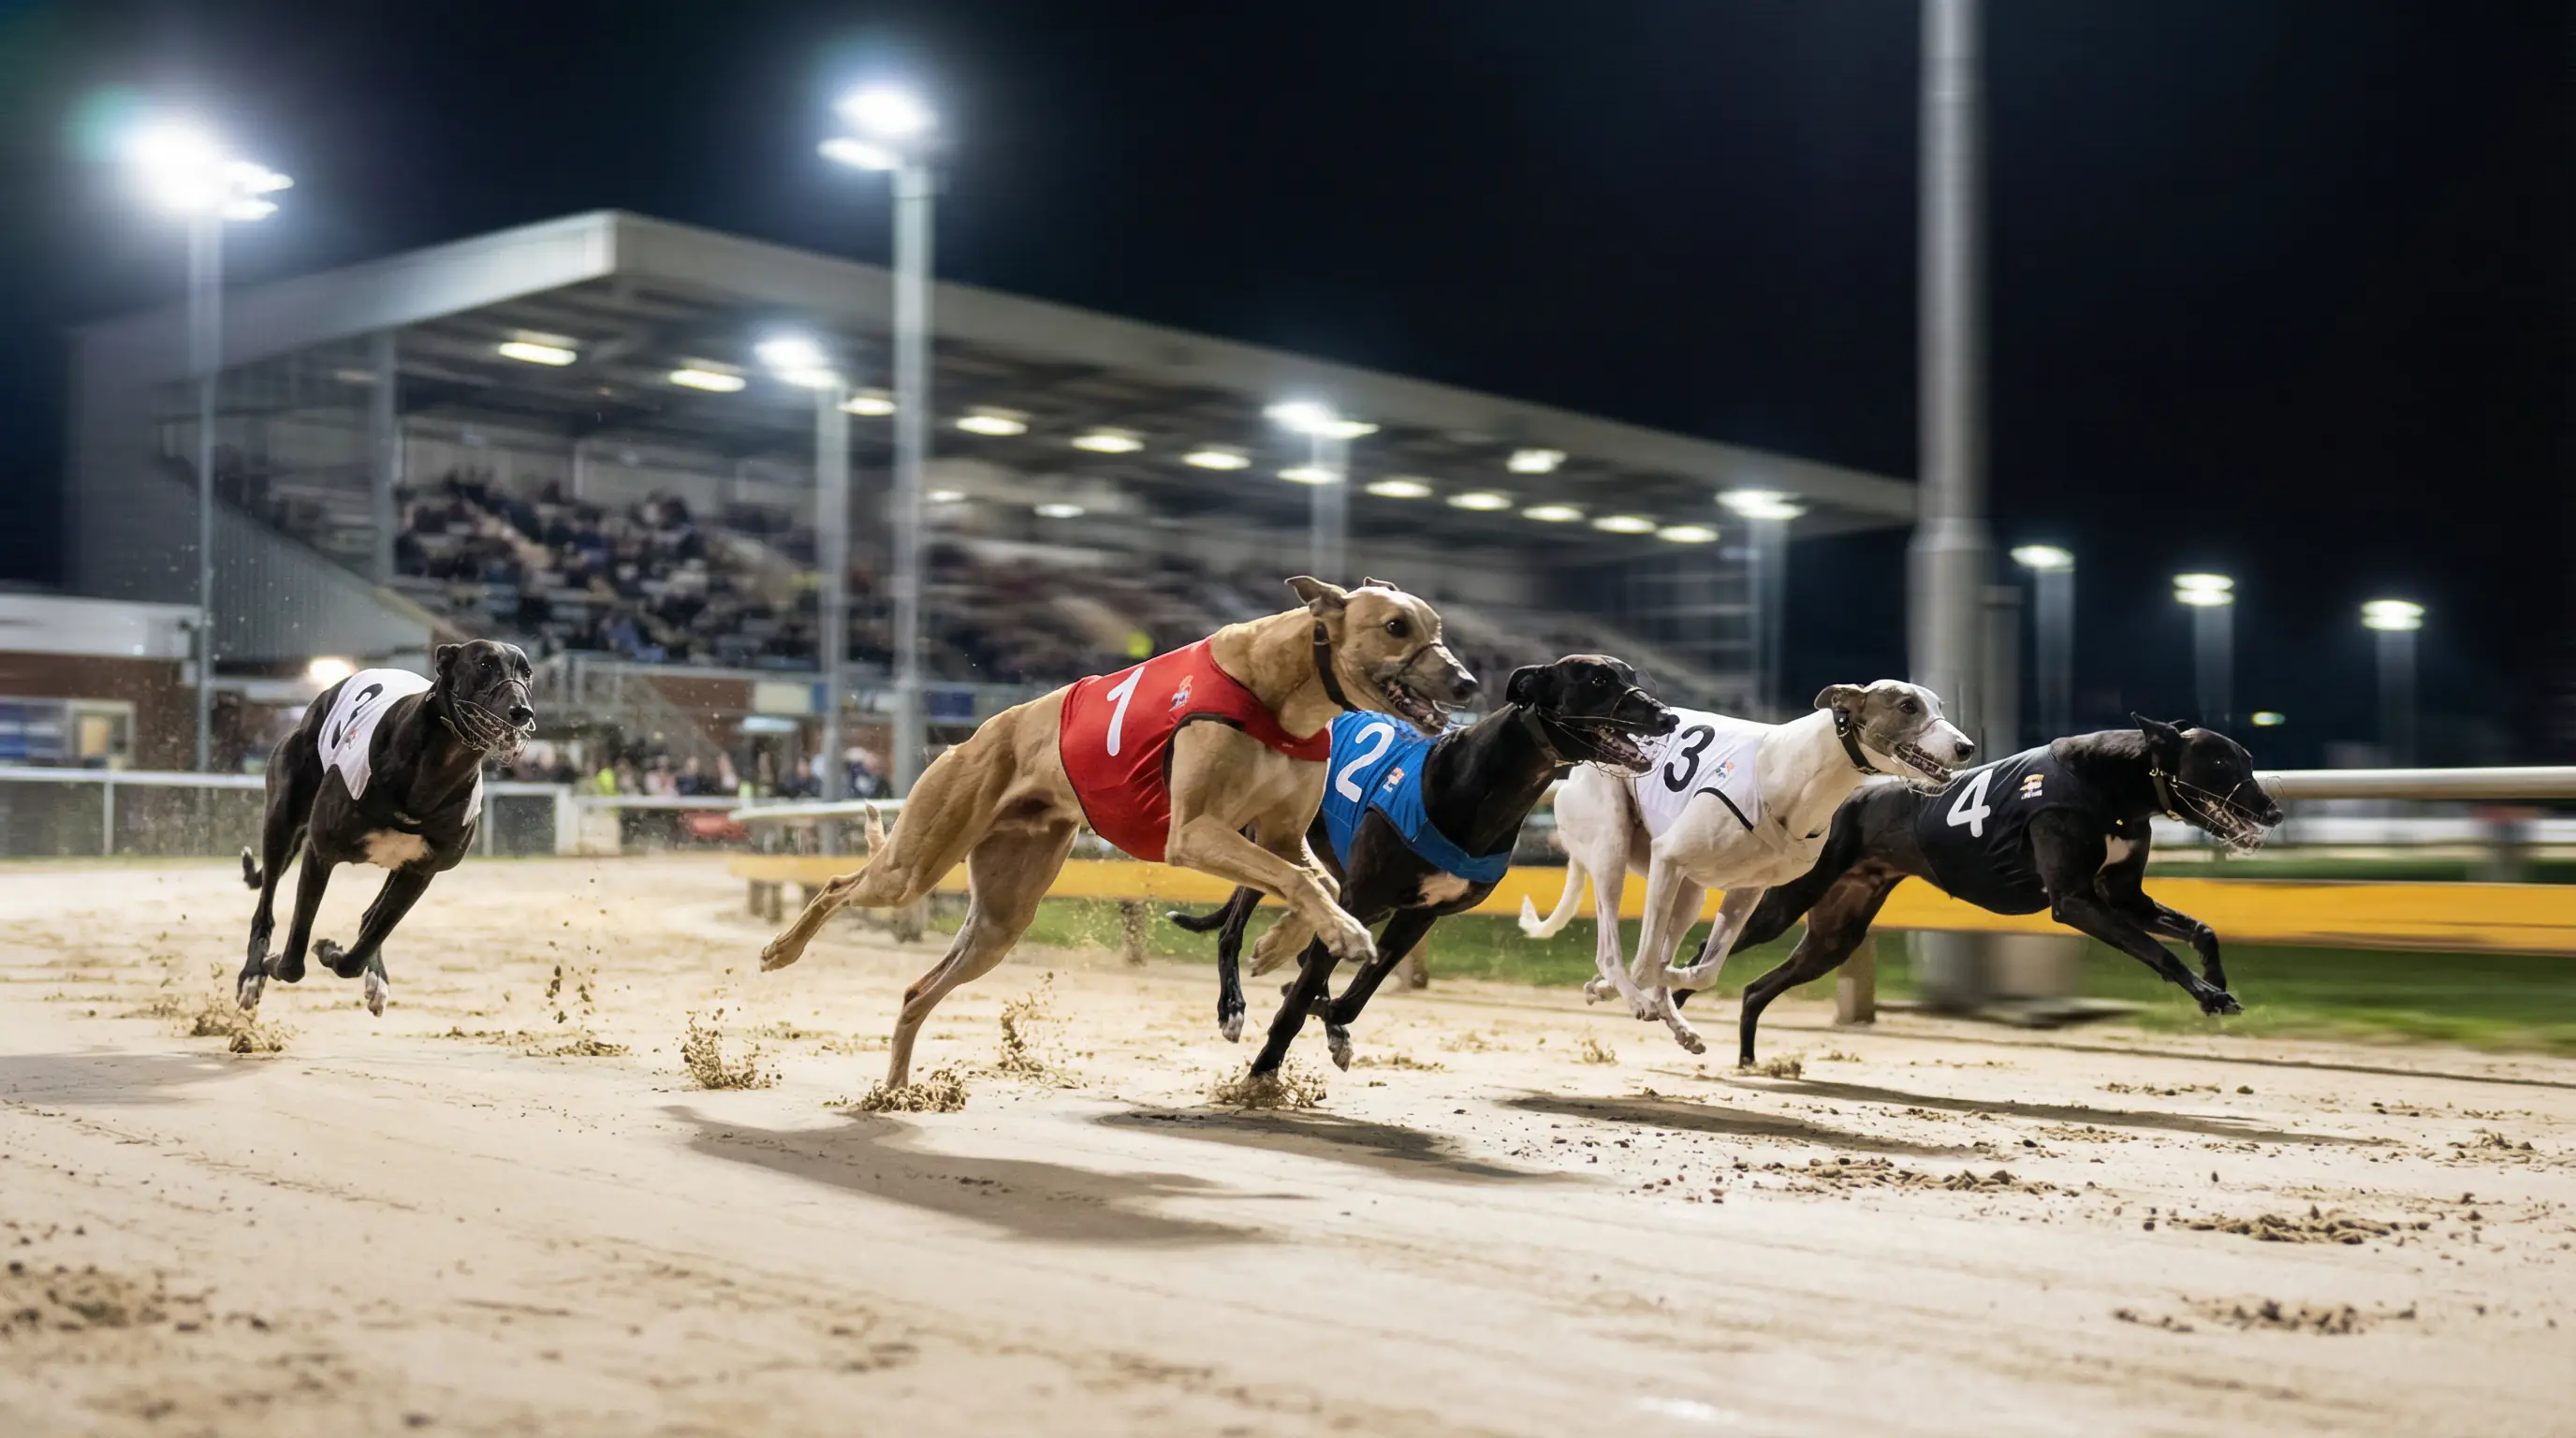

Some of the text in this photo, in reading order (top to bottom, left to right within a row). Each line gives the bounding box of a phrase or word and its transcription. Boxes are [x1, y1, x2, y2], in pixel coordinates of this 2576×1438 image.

[1106, 666, 1145, 756] 1
[1336, 722, 1395, 803] 2
[1662, 724, 1716, 793] 3
[1946, 768, 1993, 838] 4
